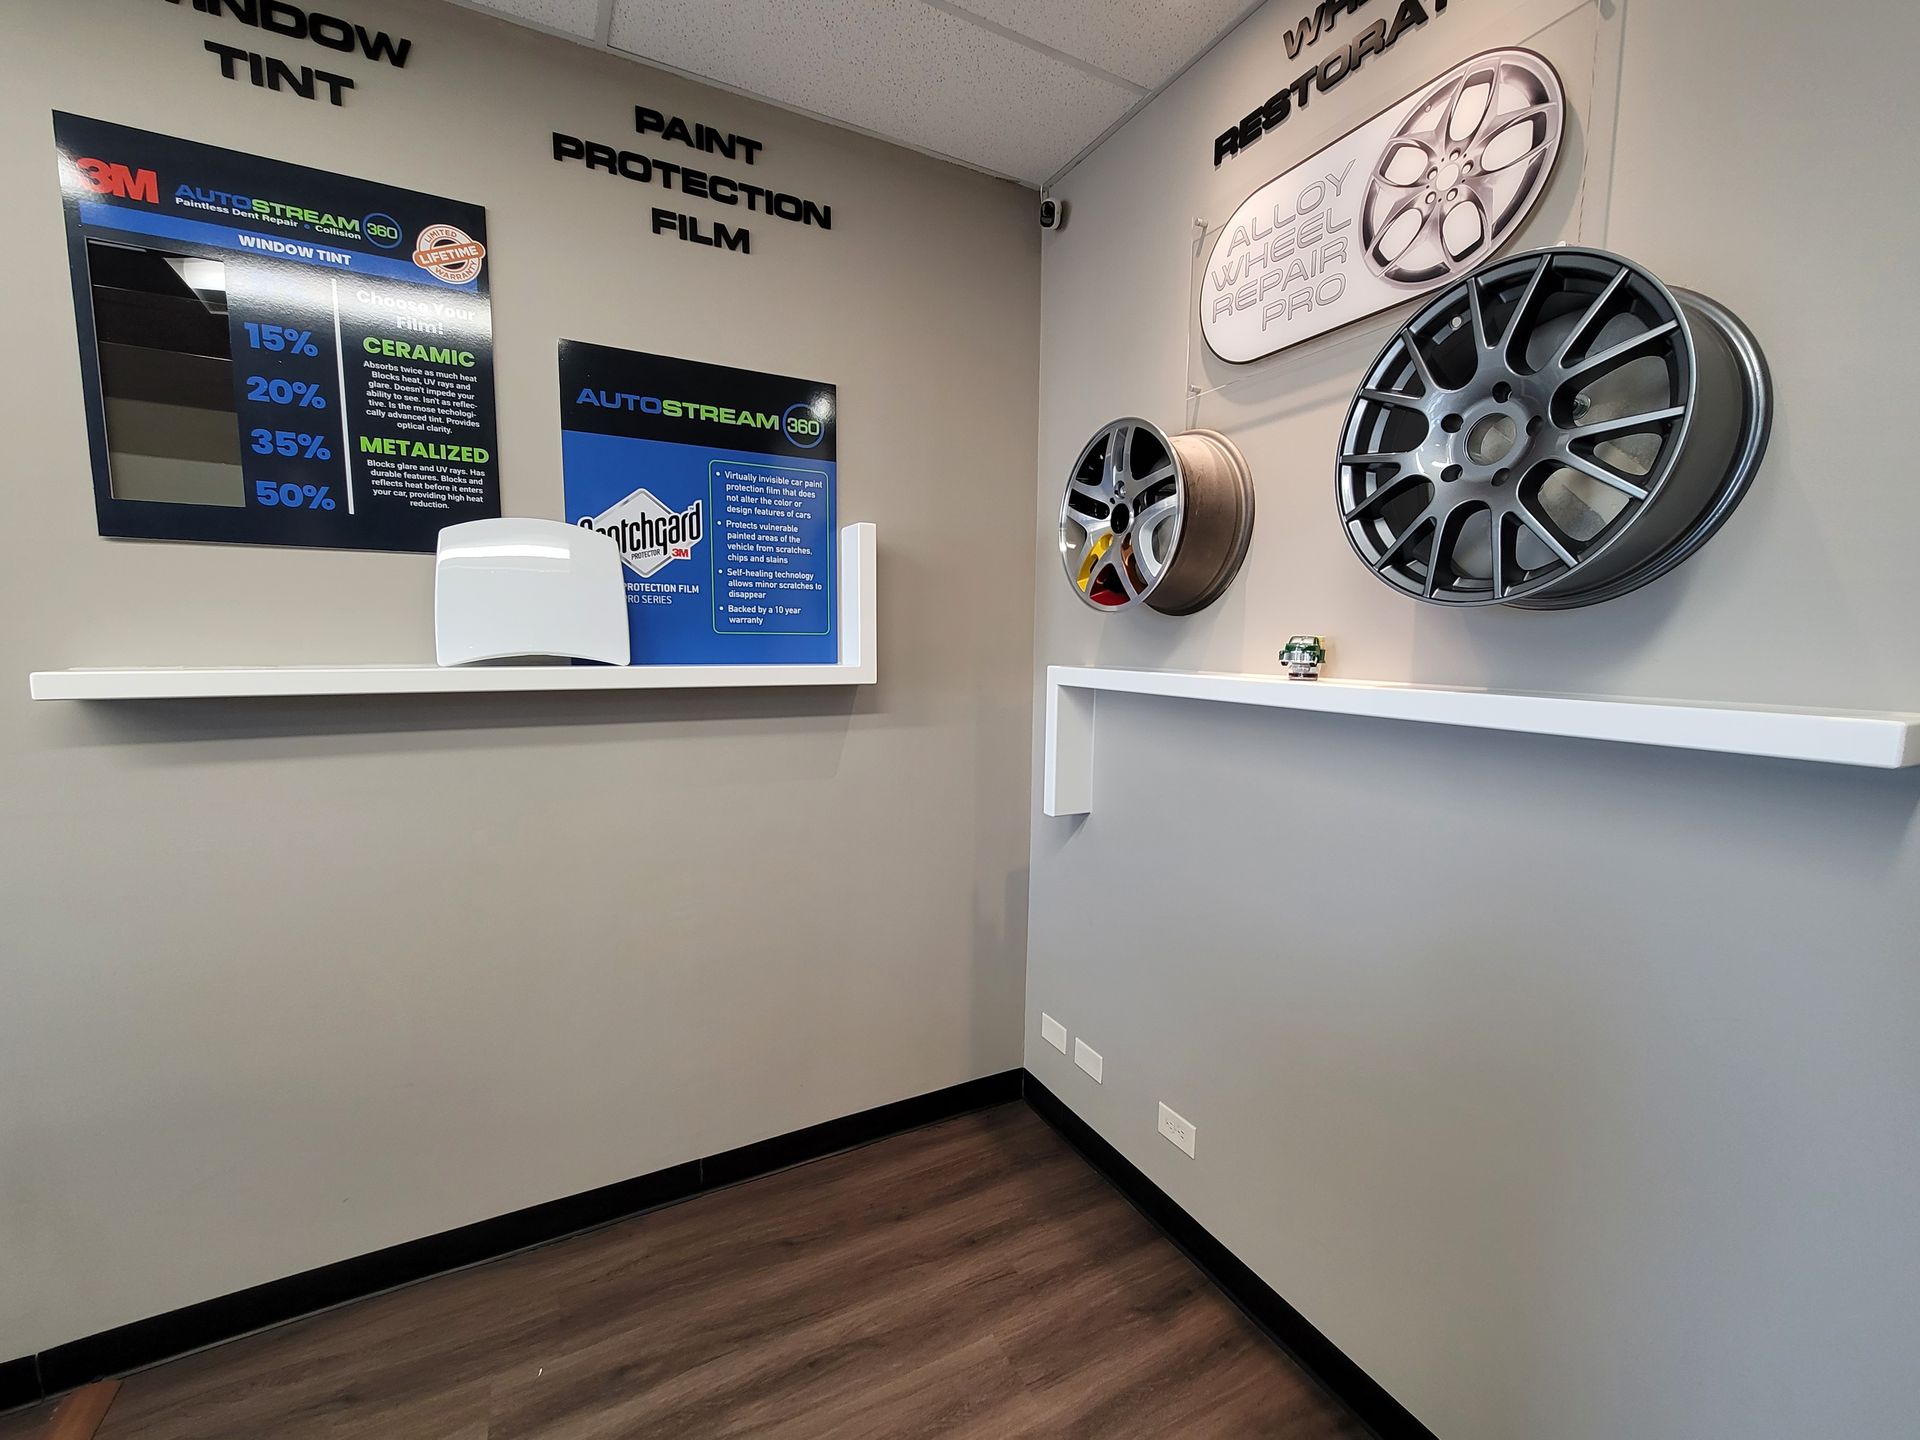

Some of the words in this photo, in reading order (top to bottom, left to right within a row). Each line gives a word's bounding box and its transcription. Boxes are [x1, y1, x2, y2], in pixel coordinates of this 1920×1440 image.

[165, 0, 411, 68] NDOW
[204, 39, 355, 107] TINT
[634, 105, 762, 165] PAINT
[75, 157, 159, 204] 3M
[552, 131, 832, 230] PROTECTION
[175, 184, 360, 232] AUTOSTREAM
[367, 222, 398, 240] 360
[1227, 159, 1356, 257] ALLOY
[176, 197, 229, 214] Paintless
[232, 208, 258, 221] Dent
[262, 214, 298, 227] Repair
[315, 225, 361, 240] Collision
[424, 229, 457, 243] LIMITED
[651, 207, 751, 254] FILM
[238, 234, 313, 258] WINDOW
[317, 250, 351, 265] TINT
[419, 245, 478, 264] LIFETIME
[1212, 208, 1351, 291] WHEEL
[436, 260, 478, 280] WARRANTY
[1213, 237, 1348, 323] REPAIR
[356, 290, 428, 313] Choose
[433, 302, 476, 320] Your
[1262, 273, 1346, 331] PRO
[244, 321, 319, 357] 15%
[363, 337, 475, 367] CERAMIC
[364, 360, 398, 371] Absorbs
[400, 366, 422, 375] twice
[436, 371, 458, 379] much
[460, 374, 477, 382] heat
[372, 371, 400, 381] Blocks
[438, 381, 454, 389] rays
[247, 375, 326, 409] 20%
[368, 381, 392, 389] glare.
[394, 383, 424, 393] Doesn't
[427, 388, 455, 398] impede
[366, 390, 391, 400] ability
[423, 397, 439, 405] Isn't
[453, 401, 477, 409] reflec-
[366, 409, 385, 418] cally
[388, 411, 426, 421] advanced
[446, 417, 480, 427] Provides
[414, 405, 436, 413] mose
[576, 388, 779, 431] AUTOSTREAM
[787, 417, 820, 436] 360
[397, 422, 424, 430] optical
[427, 425, 452, 434] clarity.
[251, 428, 331, 461] 35%
[360, 436, 489, 463] METALIZED
[367, 459, 395, 468] Blocks
[371, 469, 402, 478] durable
[404, 472, 439, 481] features.
[441, 475, 467, 484] Blocks
[372, 479, 403, 487] reflects
[405, 481, 422, 489] heat
[425, 483, 450, 491] before
[725, 471, 757, 483] Virtually
[759, 475, 789, 485] invisible
[805, 480, 822, 488] paint
[256, 480, 335, 511] 50%
[373, 488, 391, 496] your
[409, 491, 446, 501] providing
[448, 493, 464, 502] high
[726, 483, 764, 493] protection
[782, 489, 796, 497] that
[799, 490, 815, 498] does
[410, 500, 450, 509] reduction.
[740, 496, 758, 504] alter
[760, 497, 772, 505] the
[727, 505, 752, 515] design
[755, 507, 785, 517] features
[580, 502, 700, 555] otchgard
[726, 520, 757, 529] Protects
[759, 523, 798, 532] vulnerable
[728, 532, 755, 541] painted
[631, 549, 660, 560] PROTECTOR
[672, 548, 689, 557] 3M
[727, 543, 754, 551] vehicle
[756, 544, 773, 552] from
[728, 554, 748, 563] chips
[766, 556, 788, 564] stains
[727, 568, 774, 579] Self-healing
[775, 571, 814, 581] technology
[679, 585, 699, 593] FILM
[729, 590, 766, 599] disappear
[779, 582, 813, 590] scratches
[625, 595, 640, 603] RO
[642, 595, 672, 604] SERIES
[728, 605, 756, 613] Backed
[758, 606, 767, 615] by
[785, 607, 801, 615] year
[729, 617, 763, 625] warranty
